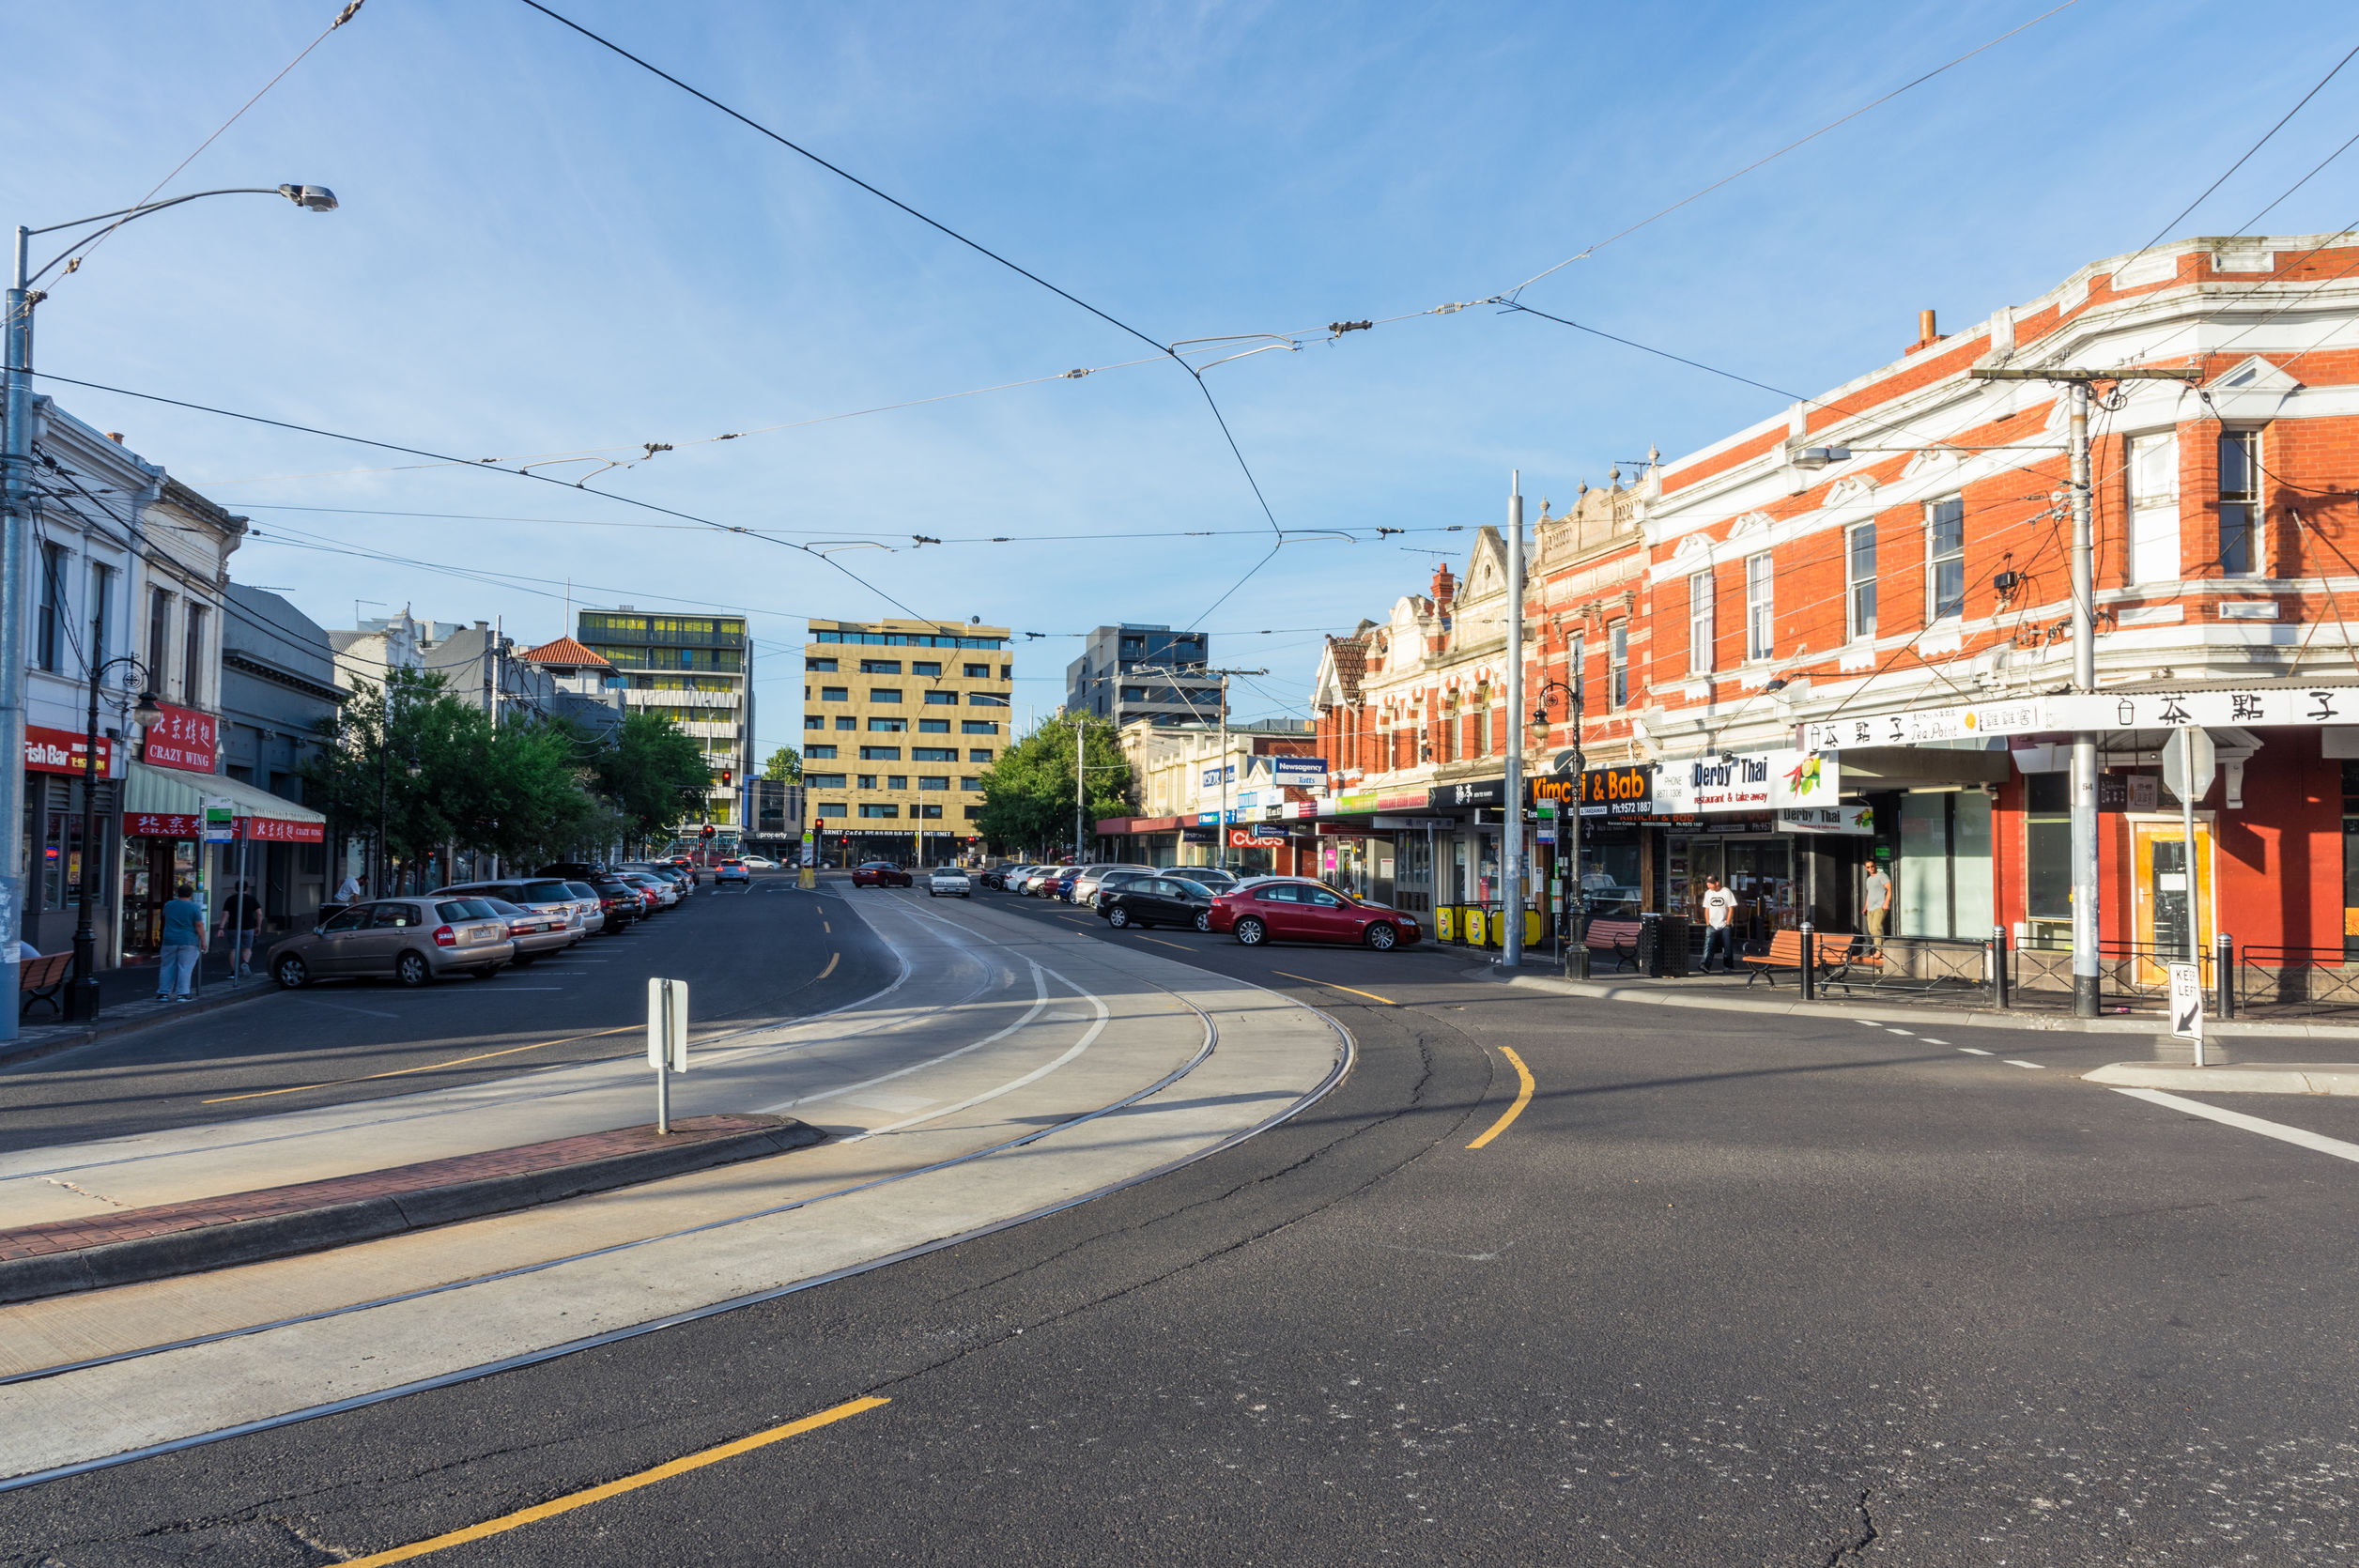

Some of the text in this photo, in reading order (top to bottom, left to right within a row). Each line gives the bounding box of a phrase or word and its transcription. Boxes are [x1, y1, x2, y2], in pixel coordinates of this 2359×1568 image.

[1910, 722, 1957, 740] Tea Point
[47, 745, 69, 766] Bar
[149, 745, 209, 767] CRAZY WING
[1279, 762, 1322, 773] Newsagency
[1693, 757, 1768, 787] Derby Thai
[1534, 768, 1644, 805] Kimci & Bab
[1664, 776, 1682, 786] PHONE
[2083, 782, 2093, 792] 54
[1694, 792, 1767, 805] restaurant & take away
[1612, 801, 1652, 815] Ph:9572 1887
[1784, 808, 1813, 822] Derby
[1820, 809, 1841, 823] Thai
[2176, 968, 2196, 982] KEEP
[2179, 985, 2197, 997] LEFT
